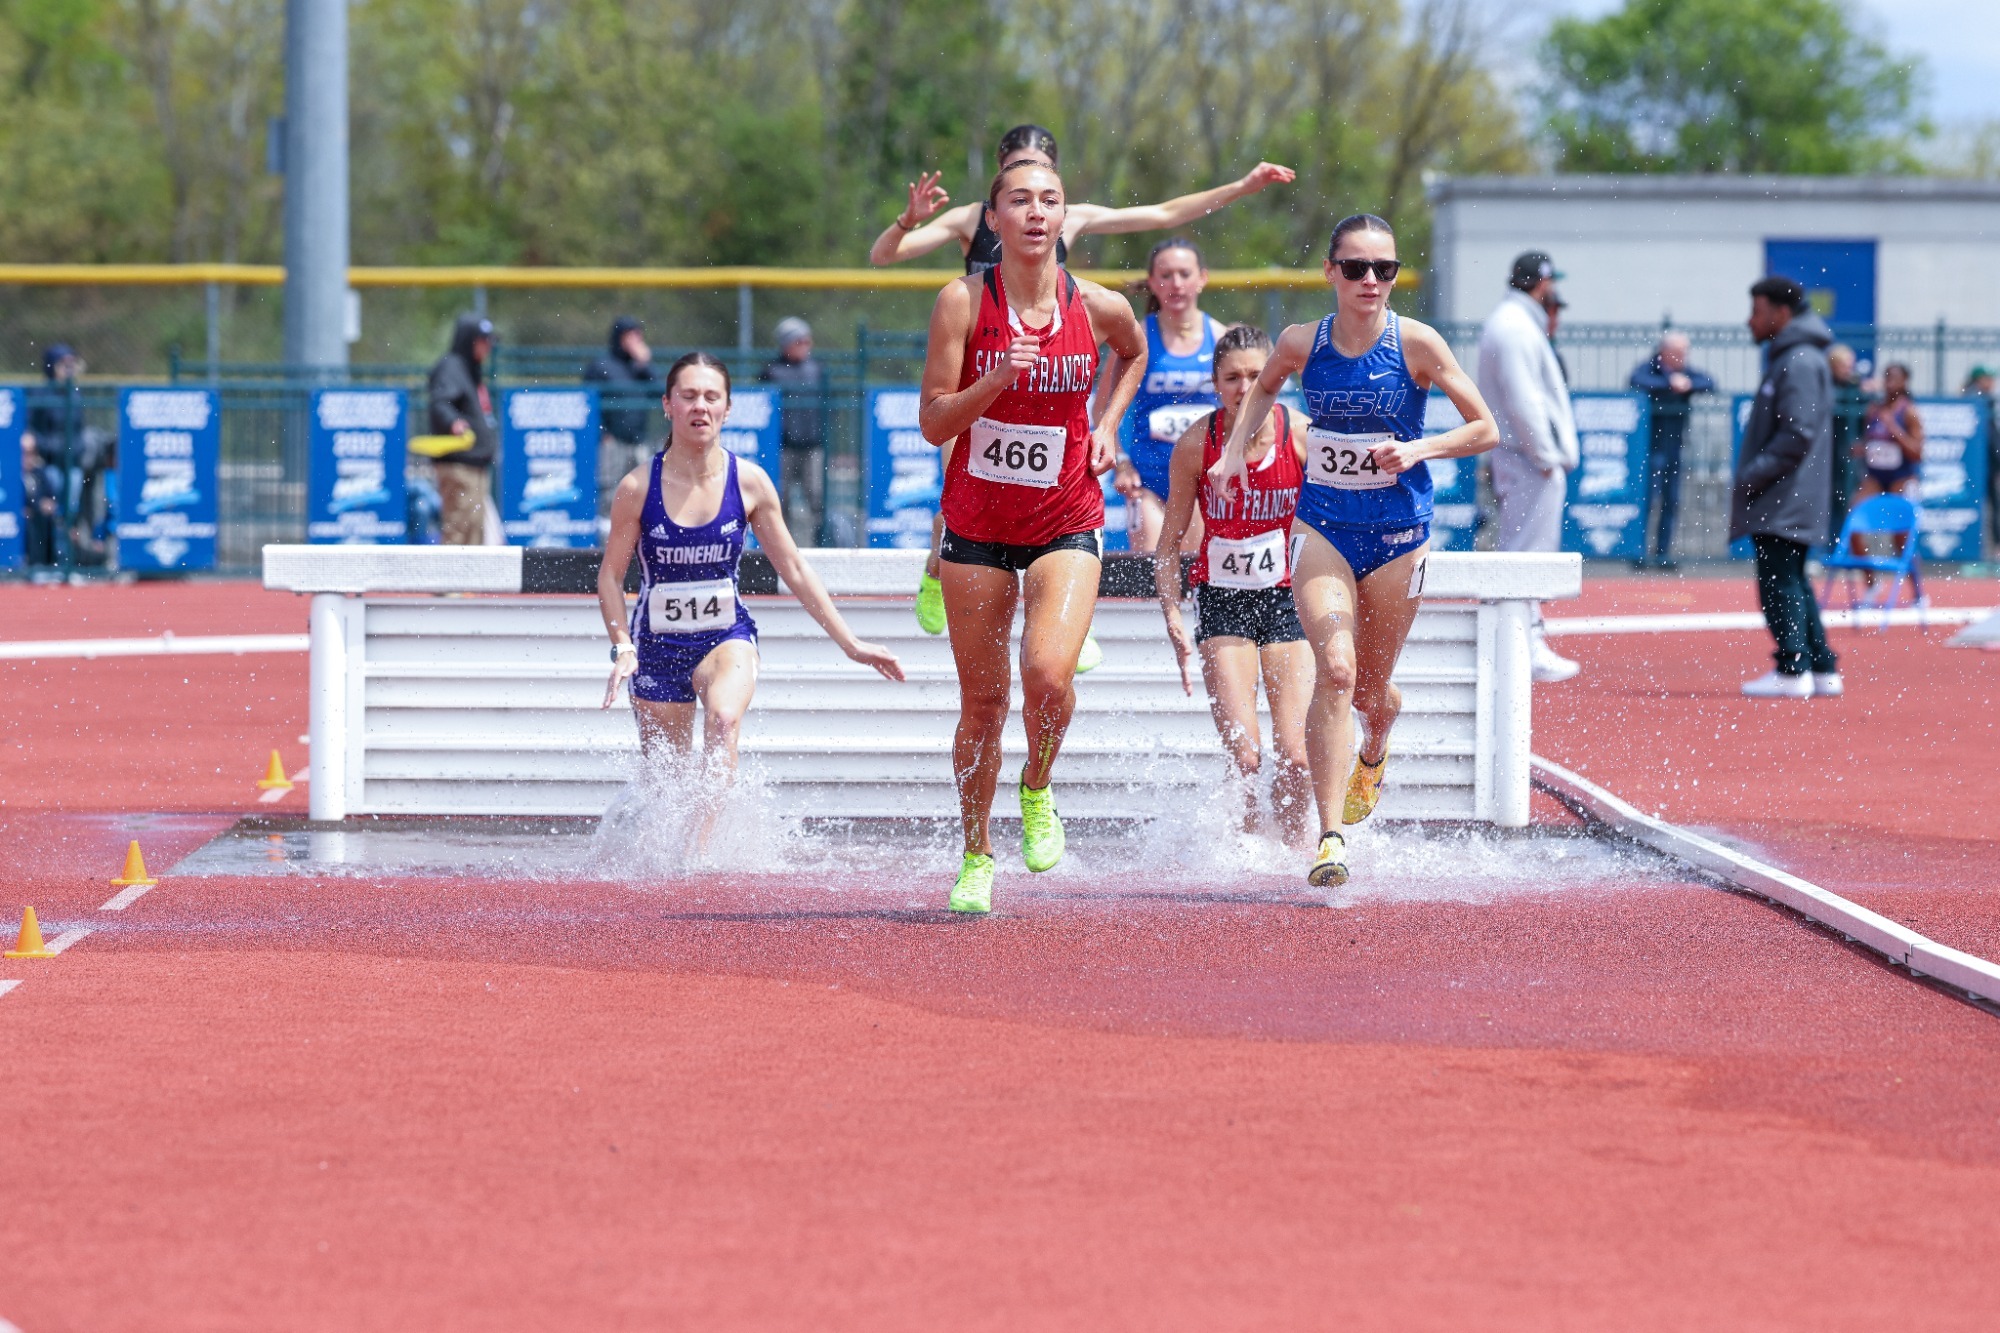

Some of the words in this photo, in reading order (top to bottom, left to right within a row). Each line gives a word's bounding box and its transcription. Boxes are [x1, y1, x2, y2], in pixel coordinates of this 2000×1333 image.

[1028, 354, 1092, 392] FRANCIS
[1305, 389, 1408, 417] CCSU
[983, 438, 1049, 472] 466
[1321, 446, 1380, 475] 324
[1242, 487, 1298, 520] FRANCIS
[656, 543, 732, 565] STONEHILL
[1222, 548, 1275, 576] 474
[665, 595, 721, 621] 514
